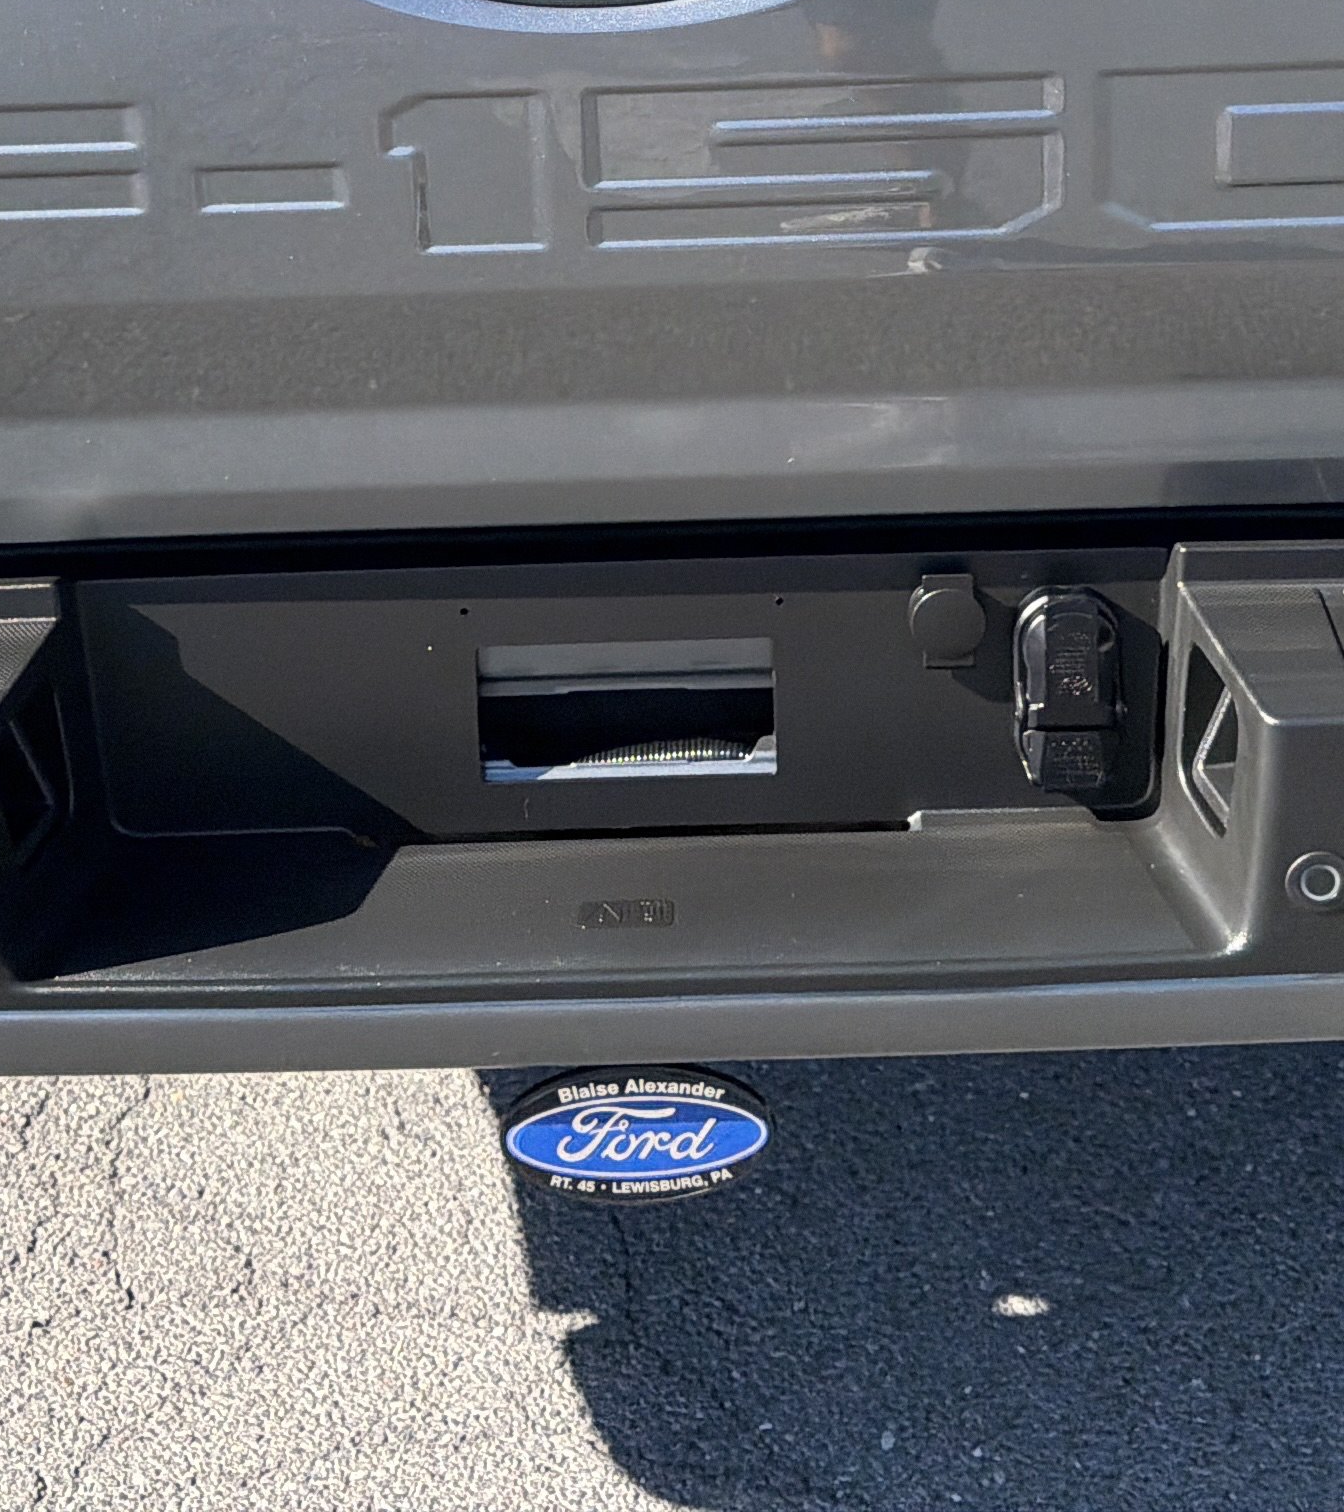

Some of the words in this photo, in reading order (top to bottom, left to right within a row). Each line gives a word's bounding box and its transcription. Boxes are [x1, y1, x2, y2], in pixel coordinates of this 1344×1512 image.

[557, 1082, 620, 1104] Blaise
[624, 1078, 726, 1101] Alexander
[556, 1106, 717, 1163] Ford
[550, 1174, 574, 1193] RT.
[576, 1179, 596, 1193] 45
[711, 1168, 734, 1185] PA
